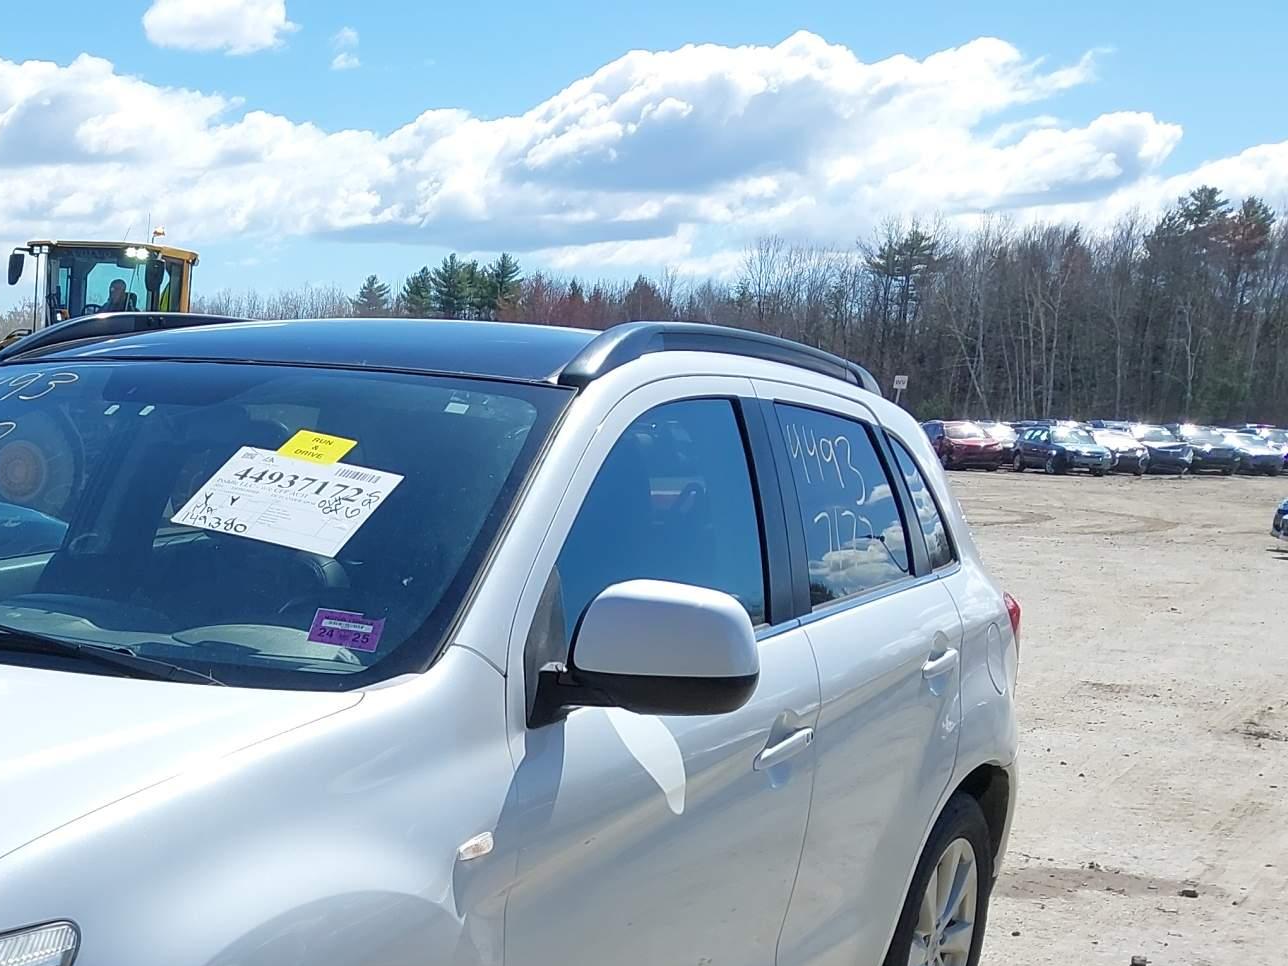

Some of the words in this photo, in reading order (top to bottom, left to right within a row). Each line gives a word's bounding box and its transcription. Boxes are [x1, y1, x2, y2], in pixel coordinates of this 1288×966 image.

[311, 437, 334, 446] RUN
[294, 448, 323, 459] DRIVE
[786, 423, 866, 505] 4493
[234, 466, 364, 503] 44937172
[317, 627, 334, 638] 24
[352, 632, 370, 644] 25
